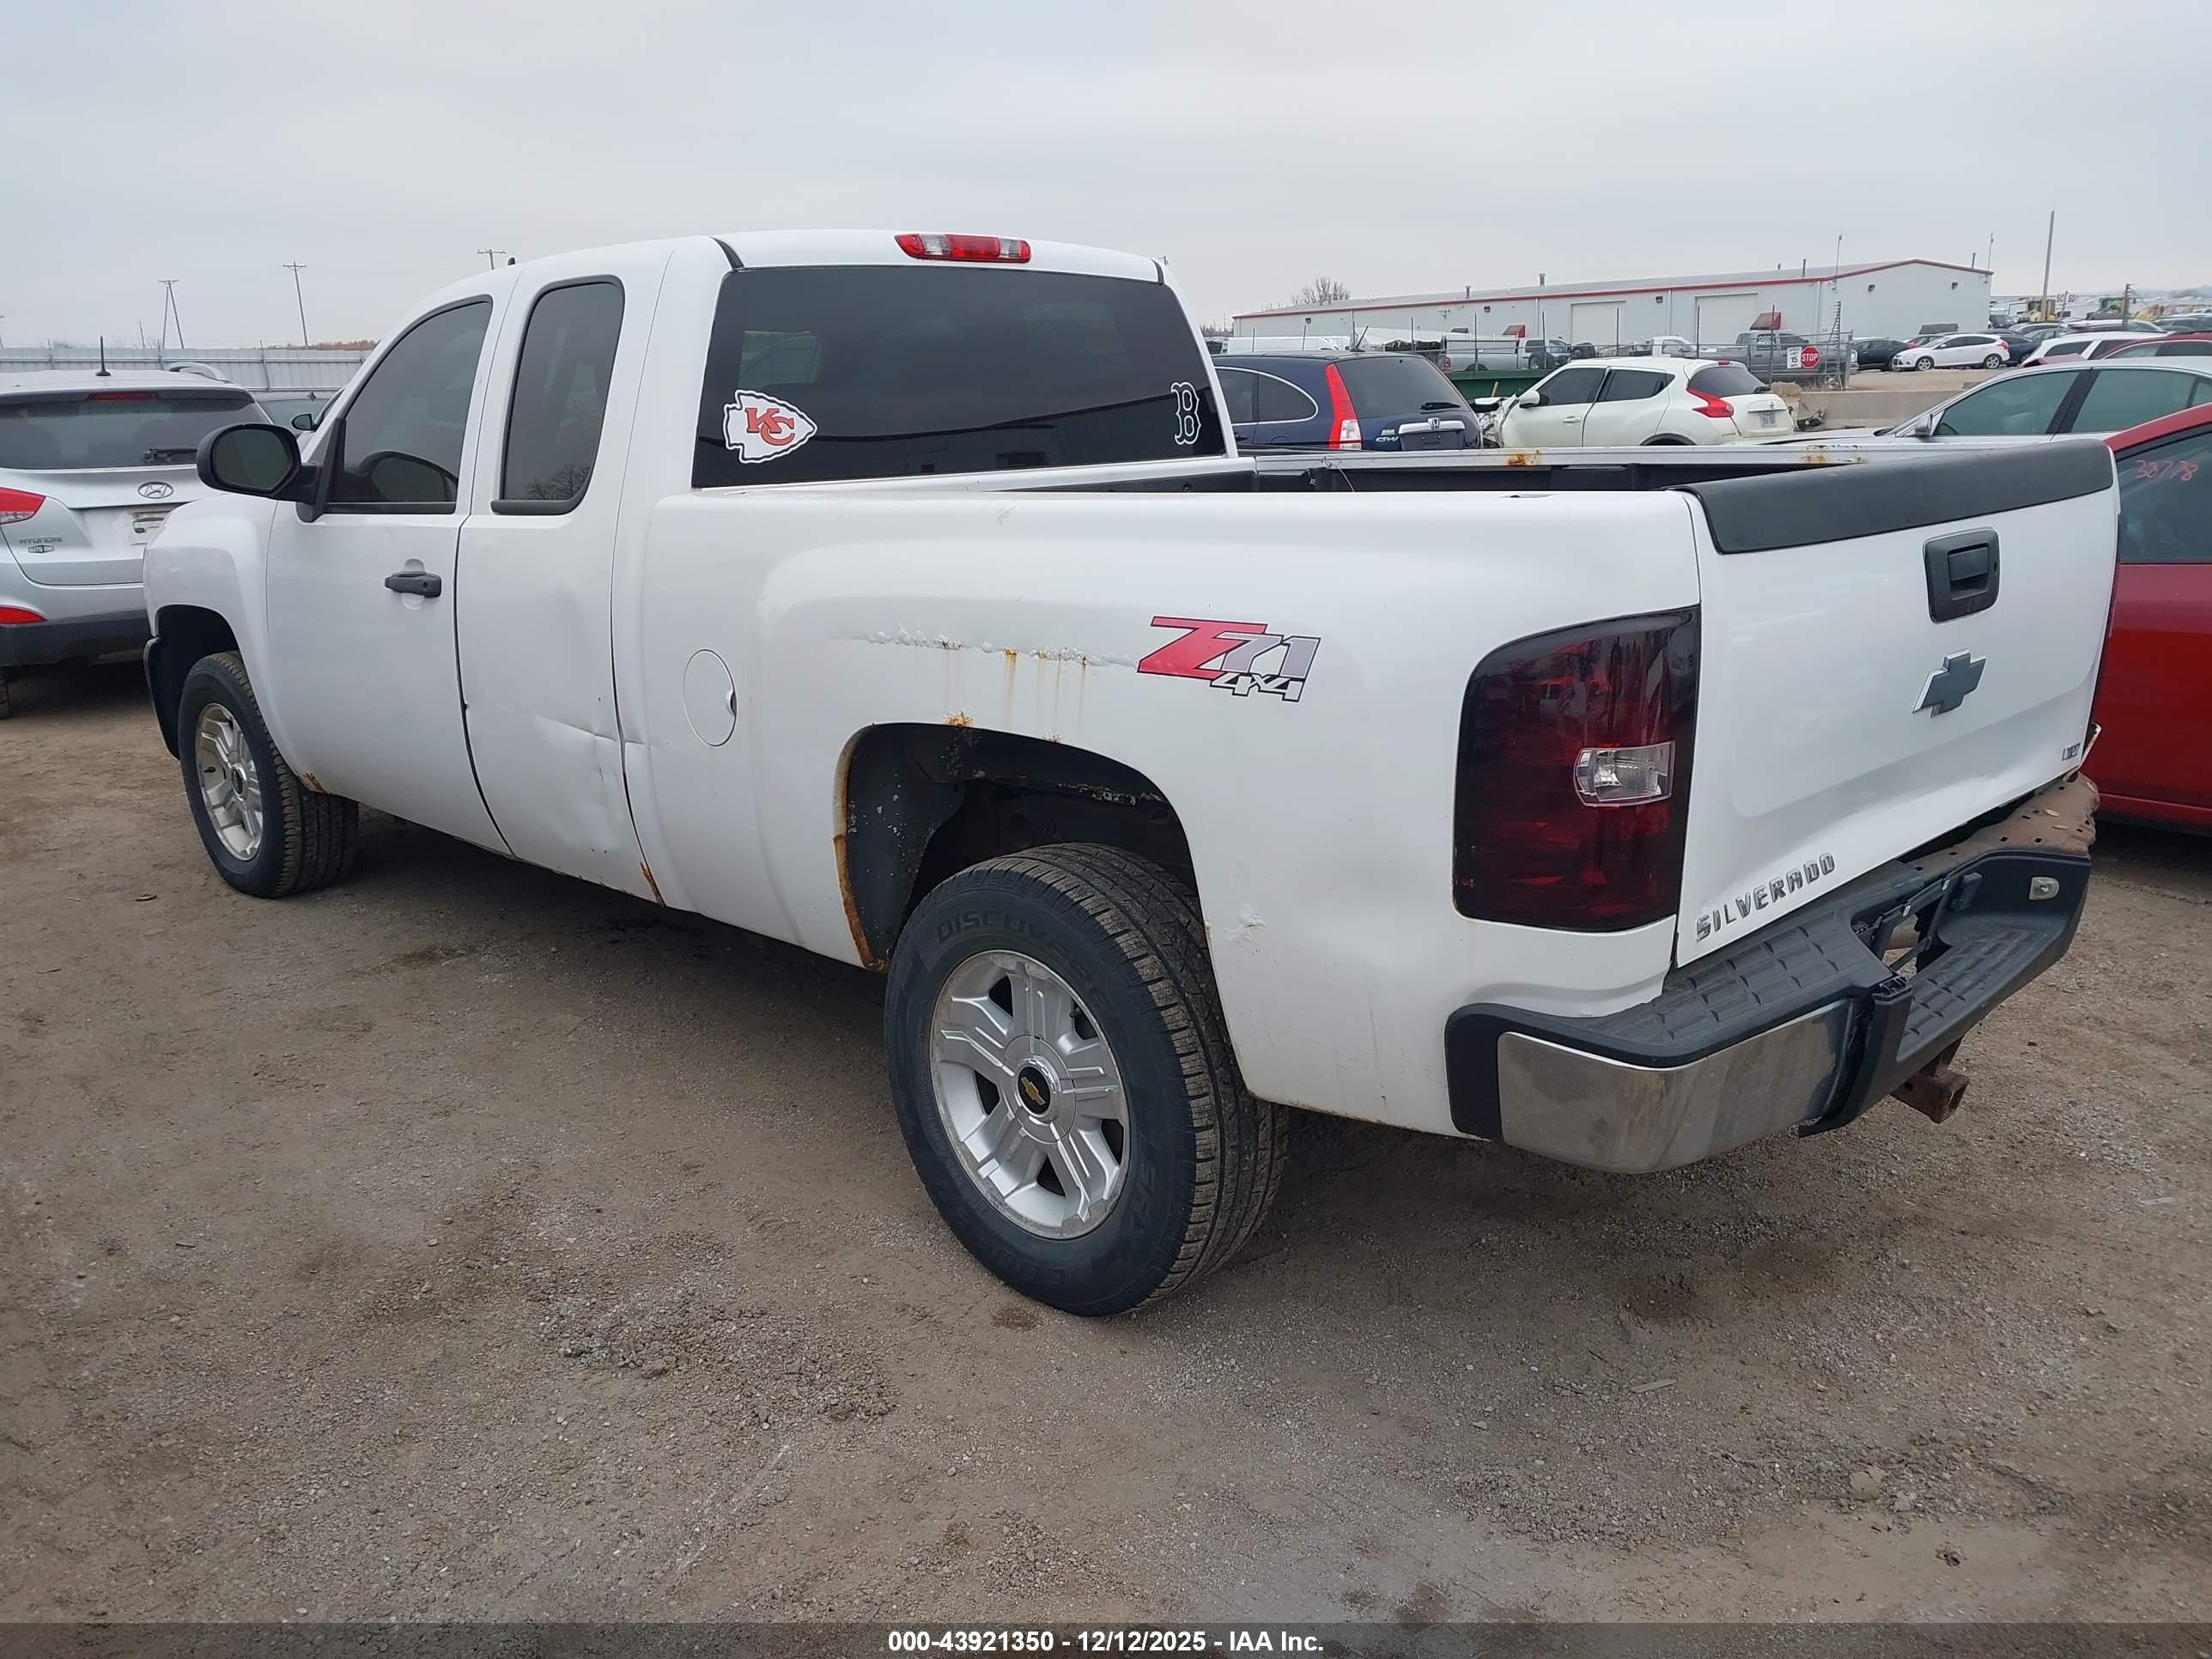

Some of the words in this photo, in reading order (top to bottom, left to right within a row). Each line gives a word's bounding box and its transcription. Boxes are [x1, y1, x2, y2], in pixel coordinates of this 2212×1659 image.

[1802, 352, 1819, 362] STOP
[744, 407, 796, 447] KC
[1170, 381, 1201, 445] B
[1137, 615, 1322, 681] Z71
[1696, 852, 1836, 944] SILVERADO
